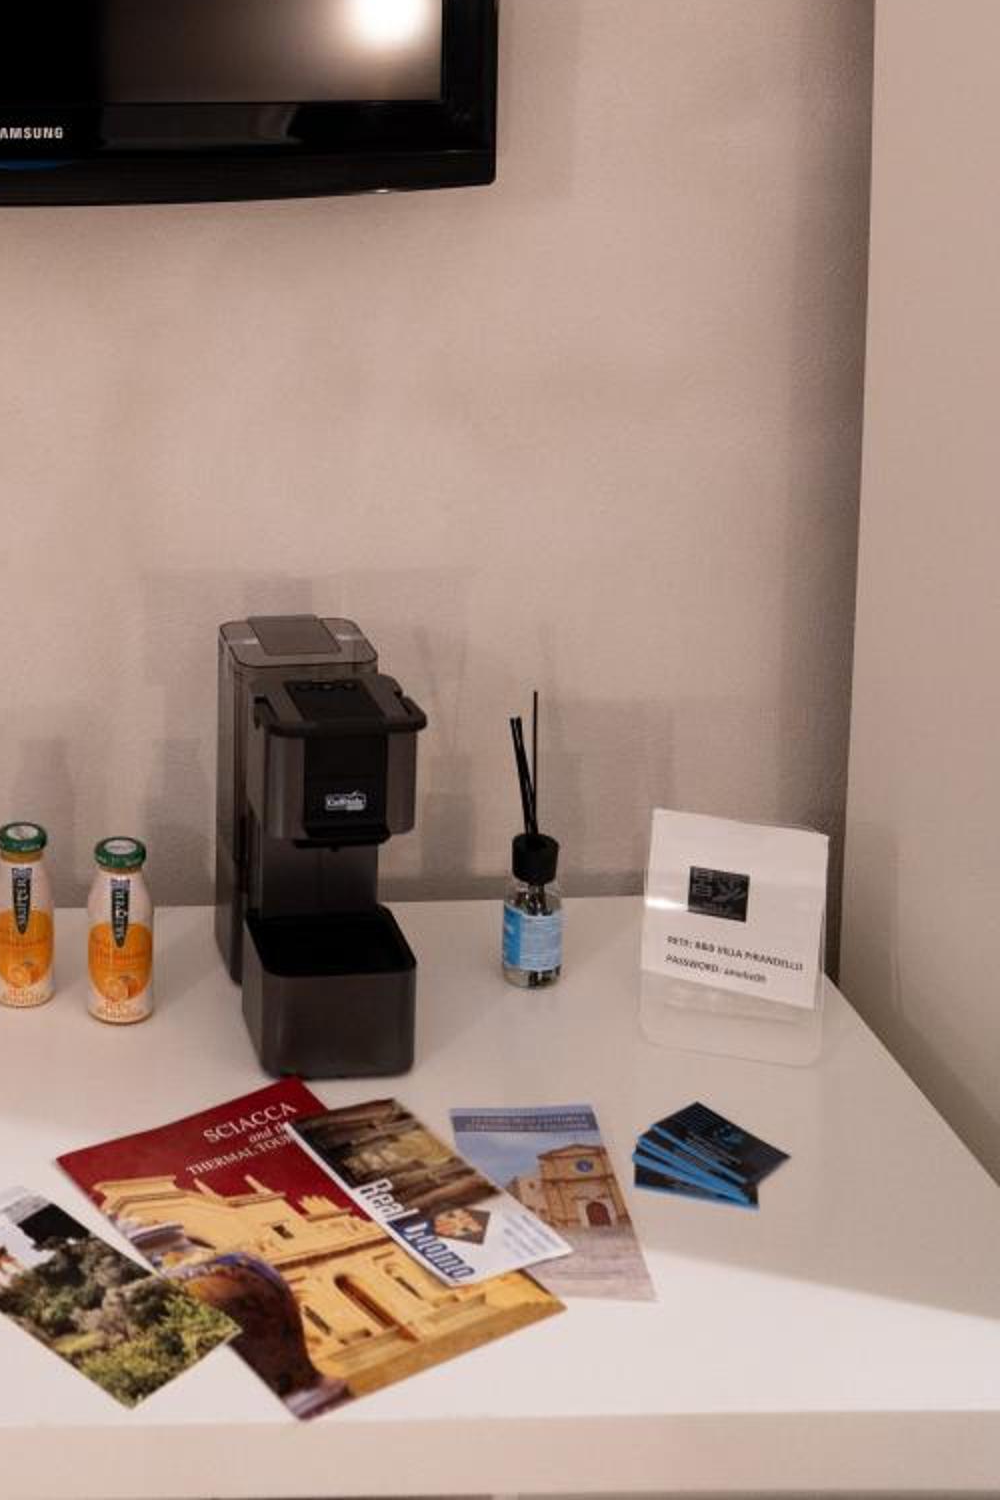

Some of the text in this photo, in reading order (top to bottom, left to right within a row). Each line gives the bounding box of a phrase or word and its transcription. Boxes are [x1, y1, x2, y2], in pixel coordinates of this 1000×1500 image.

[202, 1102, 298, 1143] SCIACCA
[249, 1125, 273, 1143] and
[185, 1147, 255, 1176] THERMAL
[353, 1177, 420, 1221] Real
